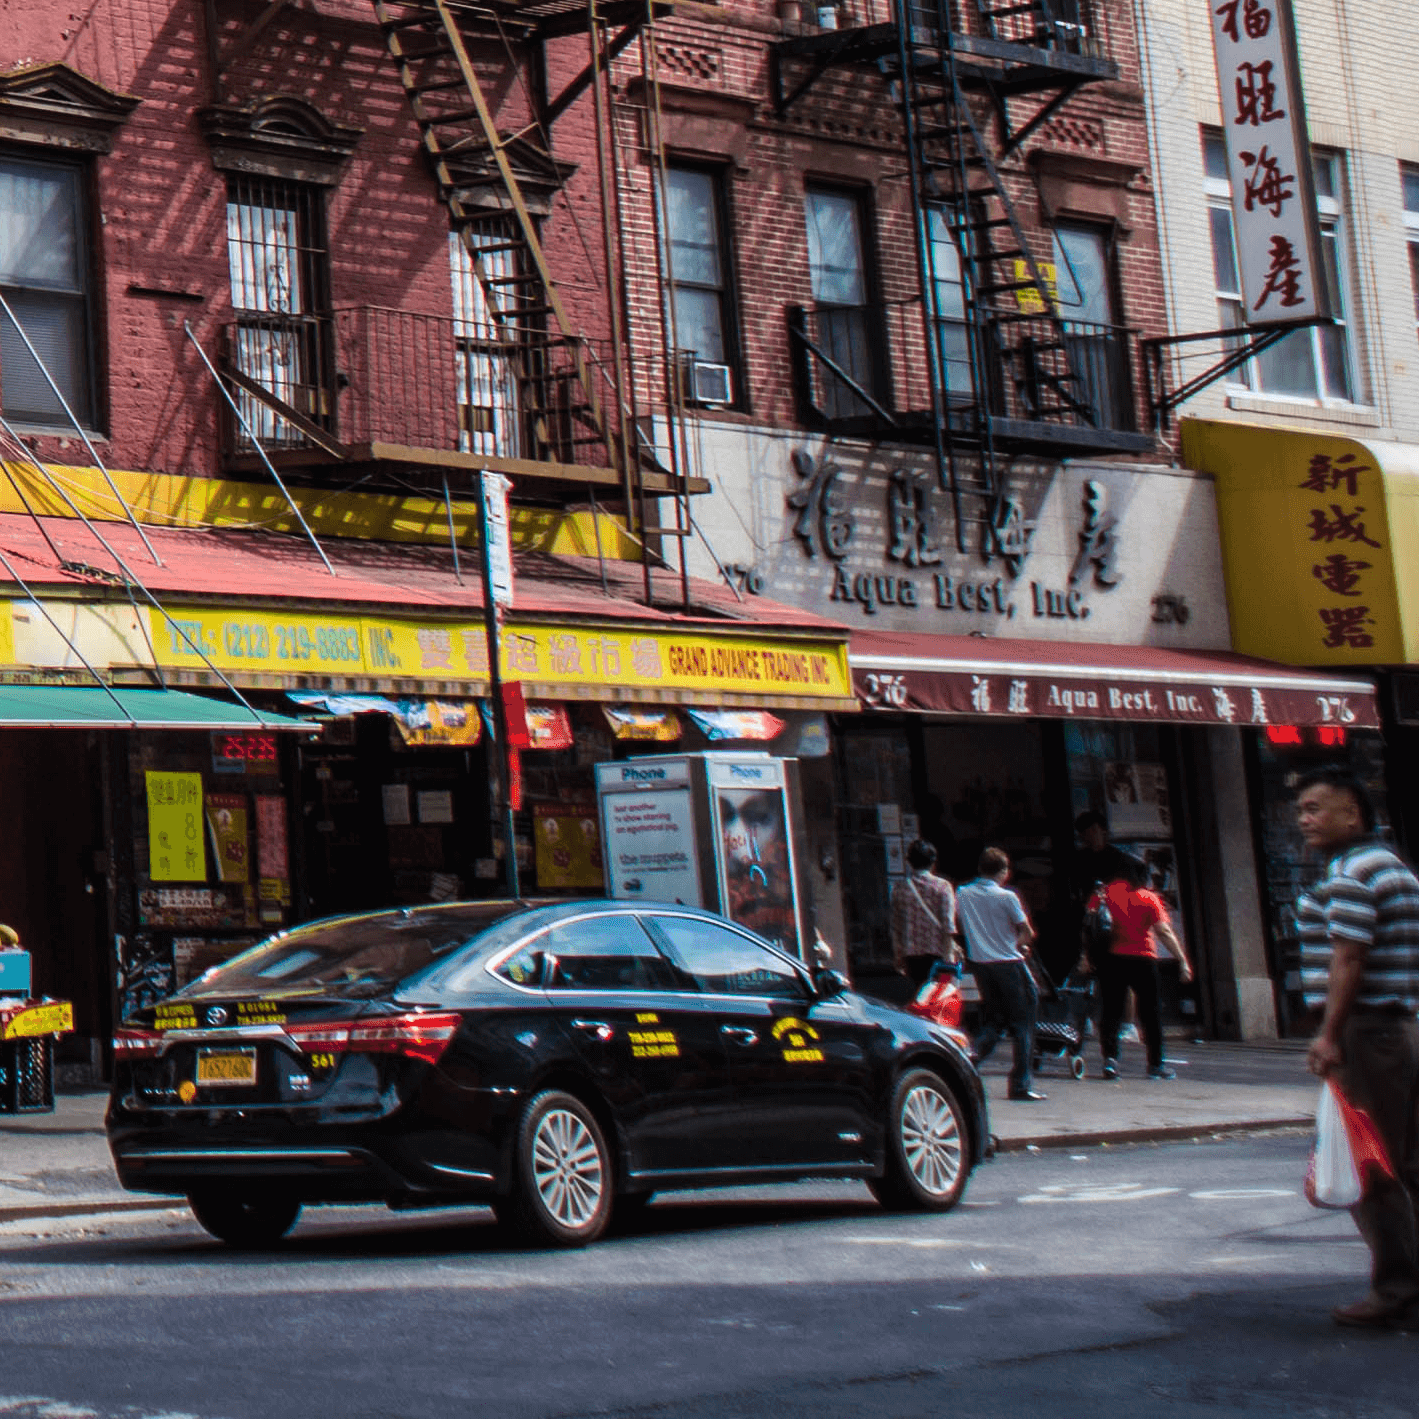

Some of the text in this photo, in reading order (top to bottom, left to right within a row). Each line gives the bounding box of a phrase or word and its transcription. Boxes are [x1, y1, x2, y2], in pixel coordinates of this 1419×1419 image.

[829, 564, 1091, 620] Aqua Best, Inc.
[1151, 593, 1189, 624] 276
[165, 620, 216, 656] TEL:
[417, 627, 663, 679] 雙喜超級市場
[669, 645, 708, 677] GRAND
[710, 647, 761, 680] ADVANCE
[762, 650, 810, 684] TRADING
[864, 673, 907, 705] 276
[1046, 684, 1203, 715] Aqua Best, Inc.
[1316, 694, 1356, 723] 276
[621, 767, 666, 782] Phone
[729, 763, 762, 779] Phone
[623, 814, 642, 822] show
[643, 812, 671, 824] starring
[629, 803, 656, 812] another
[619, 853, 639, 865] the
[311, 1053, 335, 1069] 561
